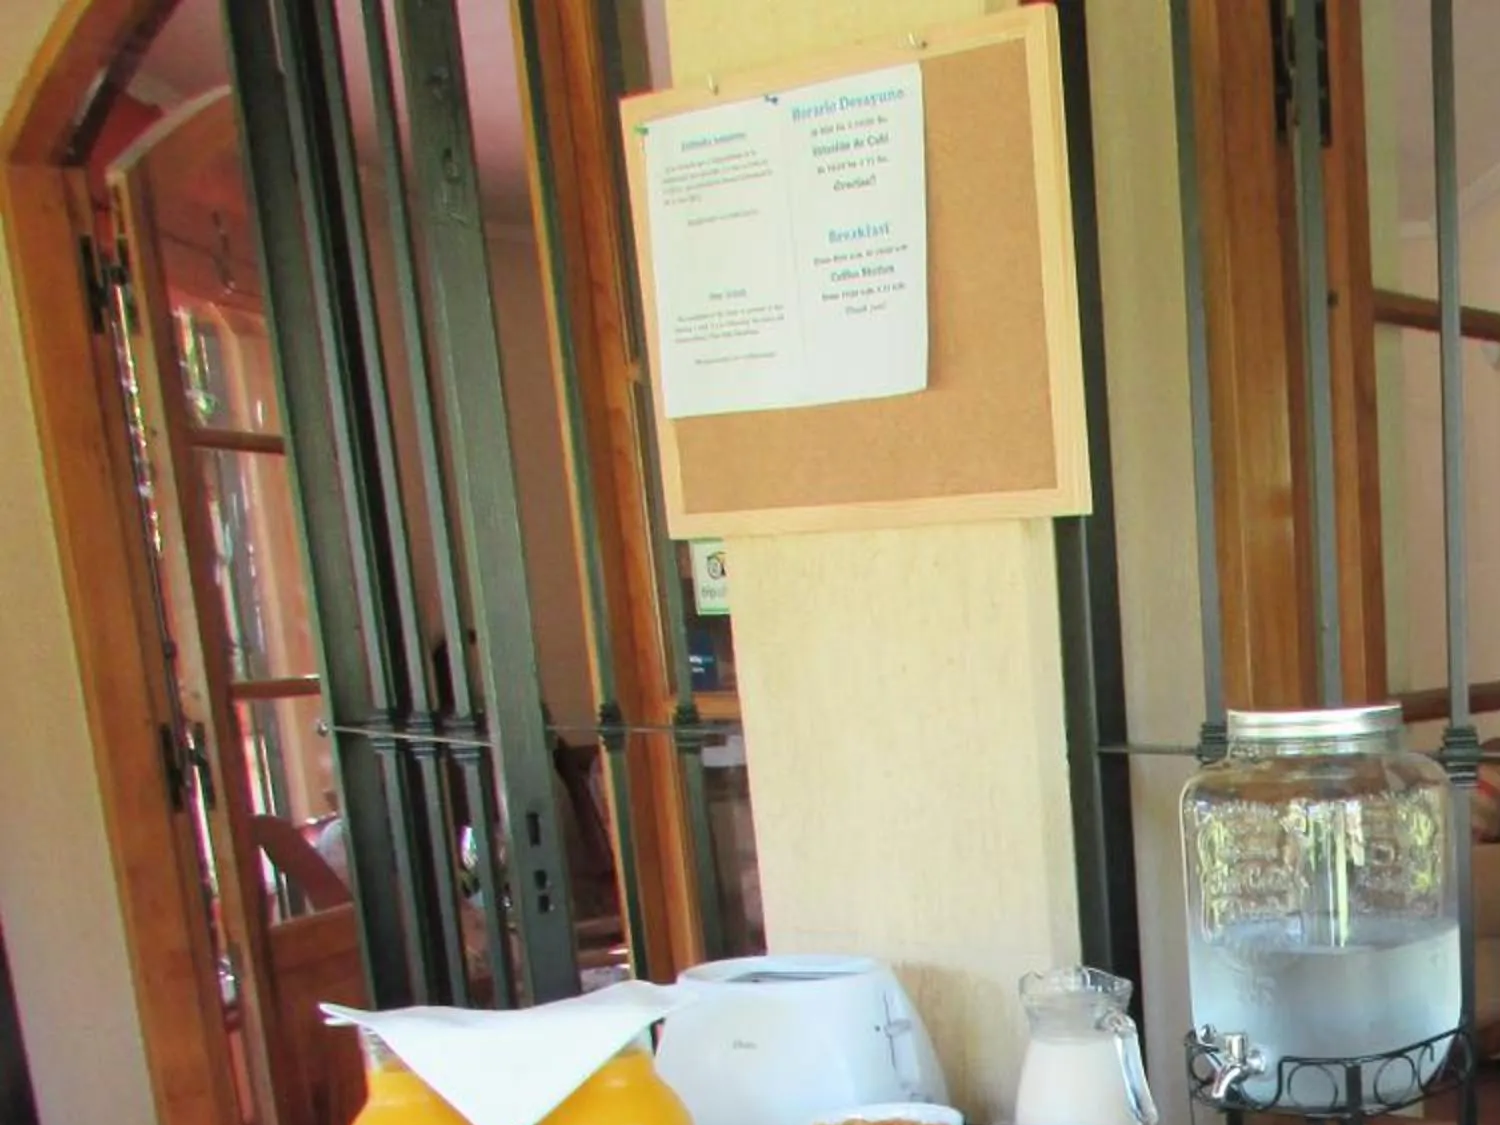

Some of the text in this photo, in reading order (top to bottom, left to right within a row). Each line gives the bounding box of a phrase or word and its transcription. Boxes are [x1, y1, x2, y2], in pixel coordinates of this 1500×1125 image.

[792, 87, 905, 122] Horario Desayuno
[828, 221, 890, 244] Breakfast
